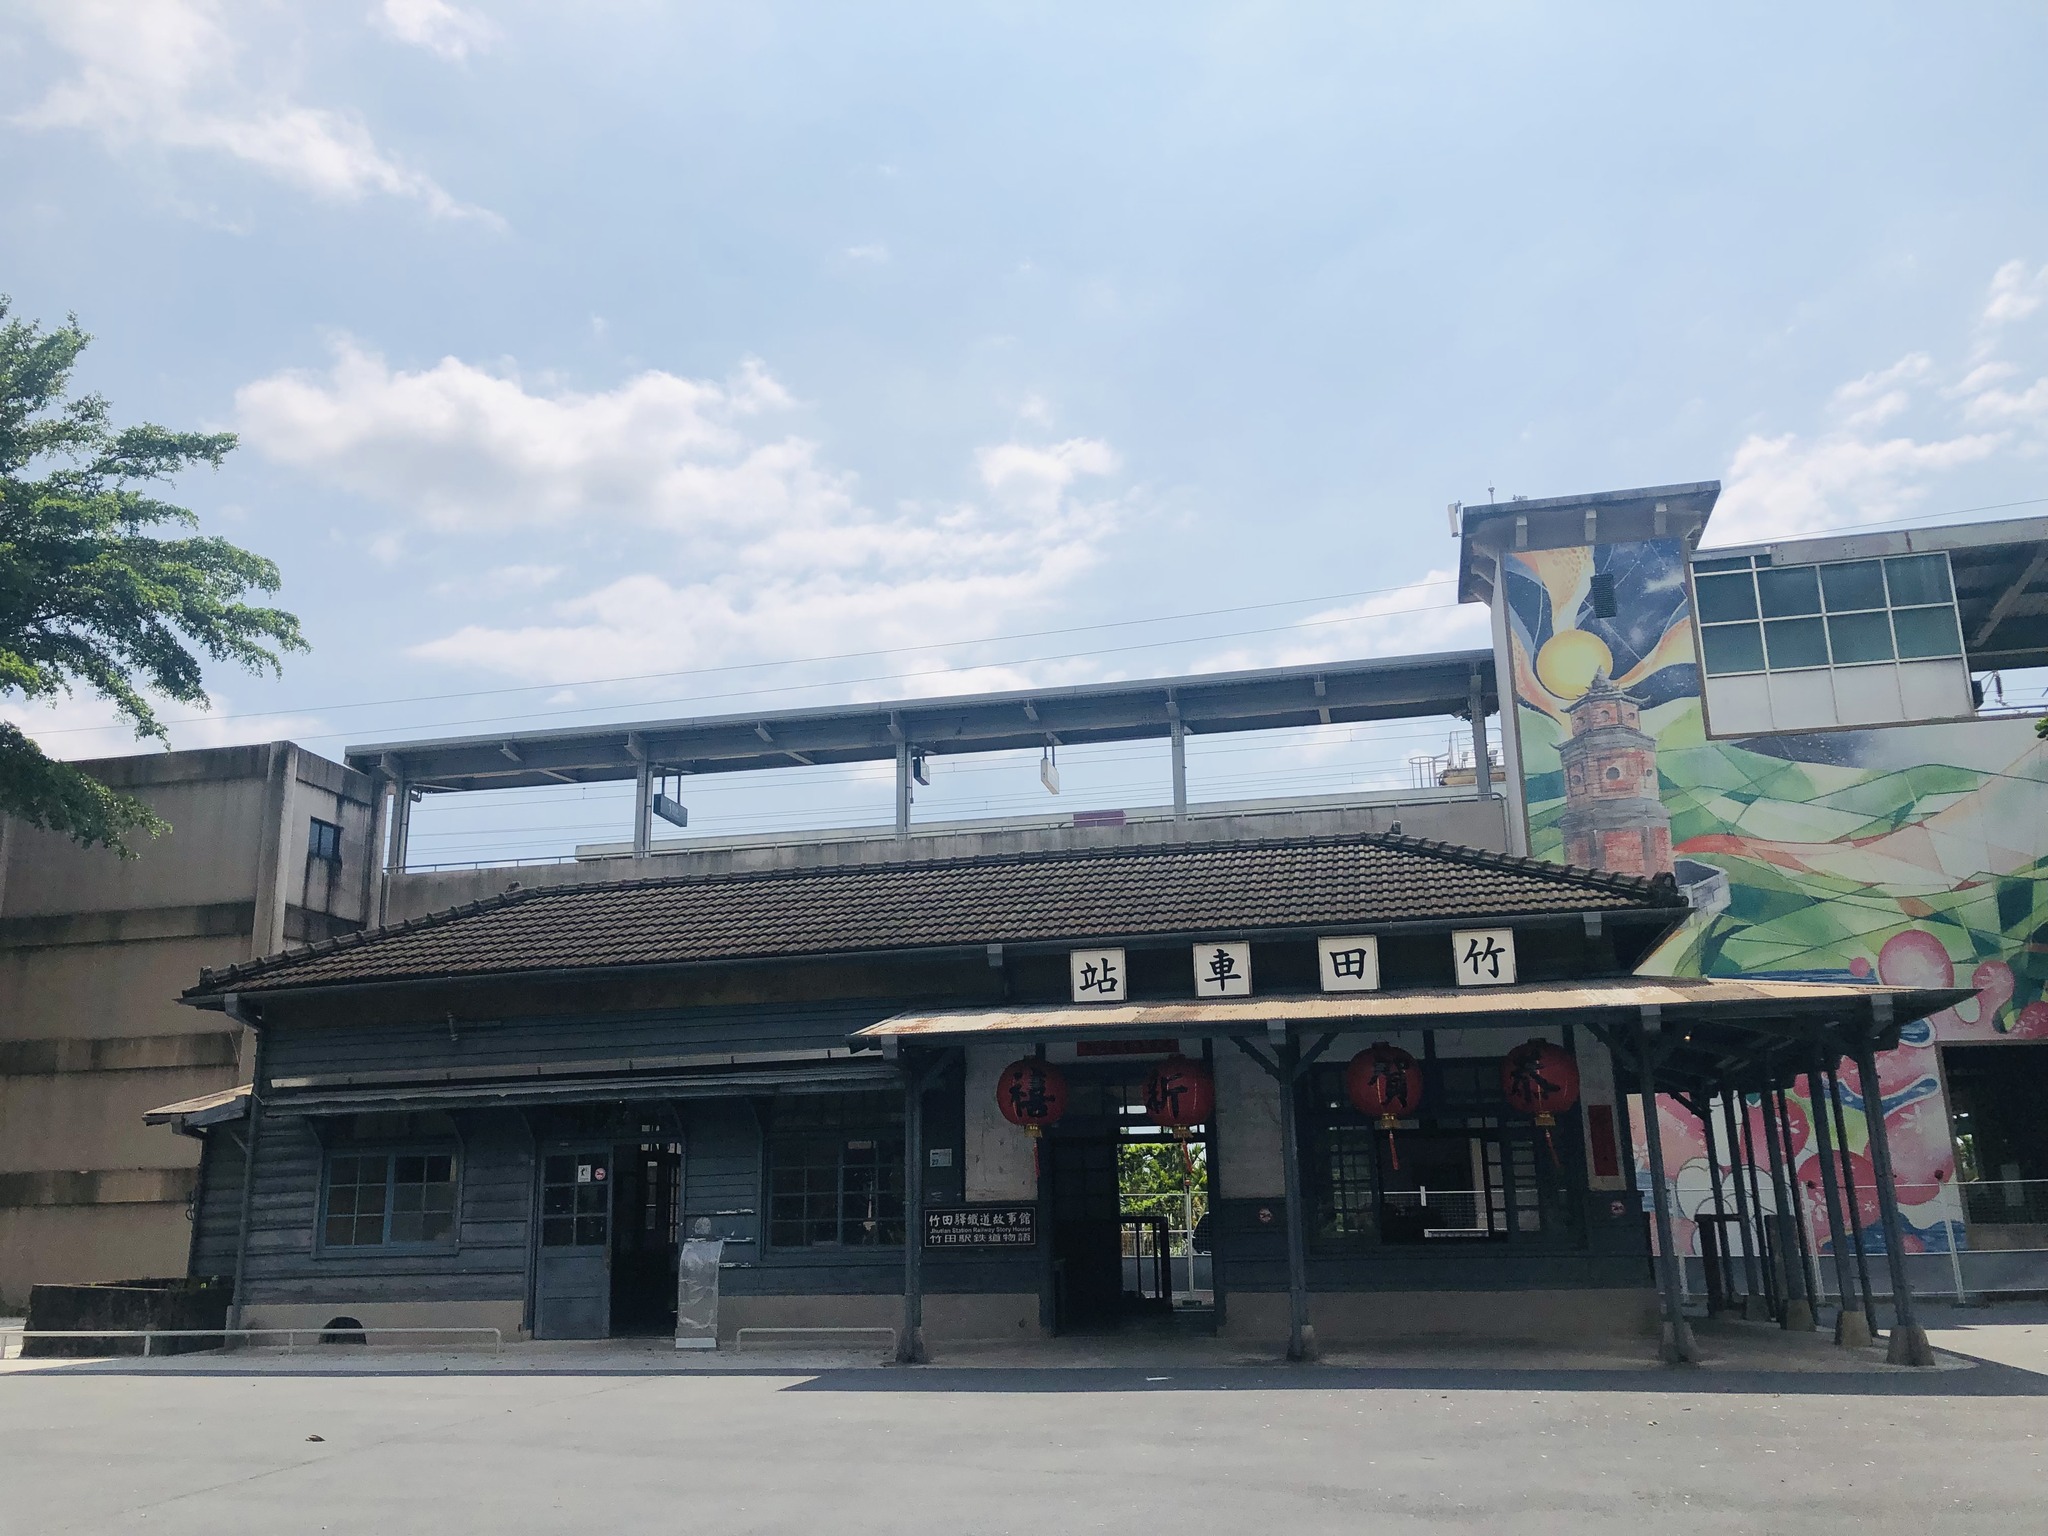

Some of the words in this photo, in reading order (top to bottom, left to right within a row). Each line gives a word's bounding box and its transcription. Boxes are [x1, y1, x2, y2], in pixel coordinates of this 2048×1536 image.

[1079, 957, 1118, 994] 站
[1204, 948, 1242, 991] 車
[1329, 948, 1367, 980] 田
[1463, 937, 1505, 979] 竹
